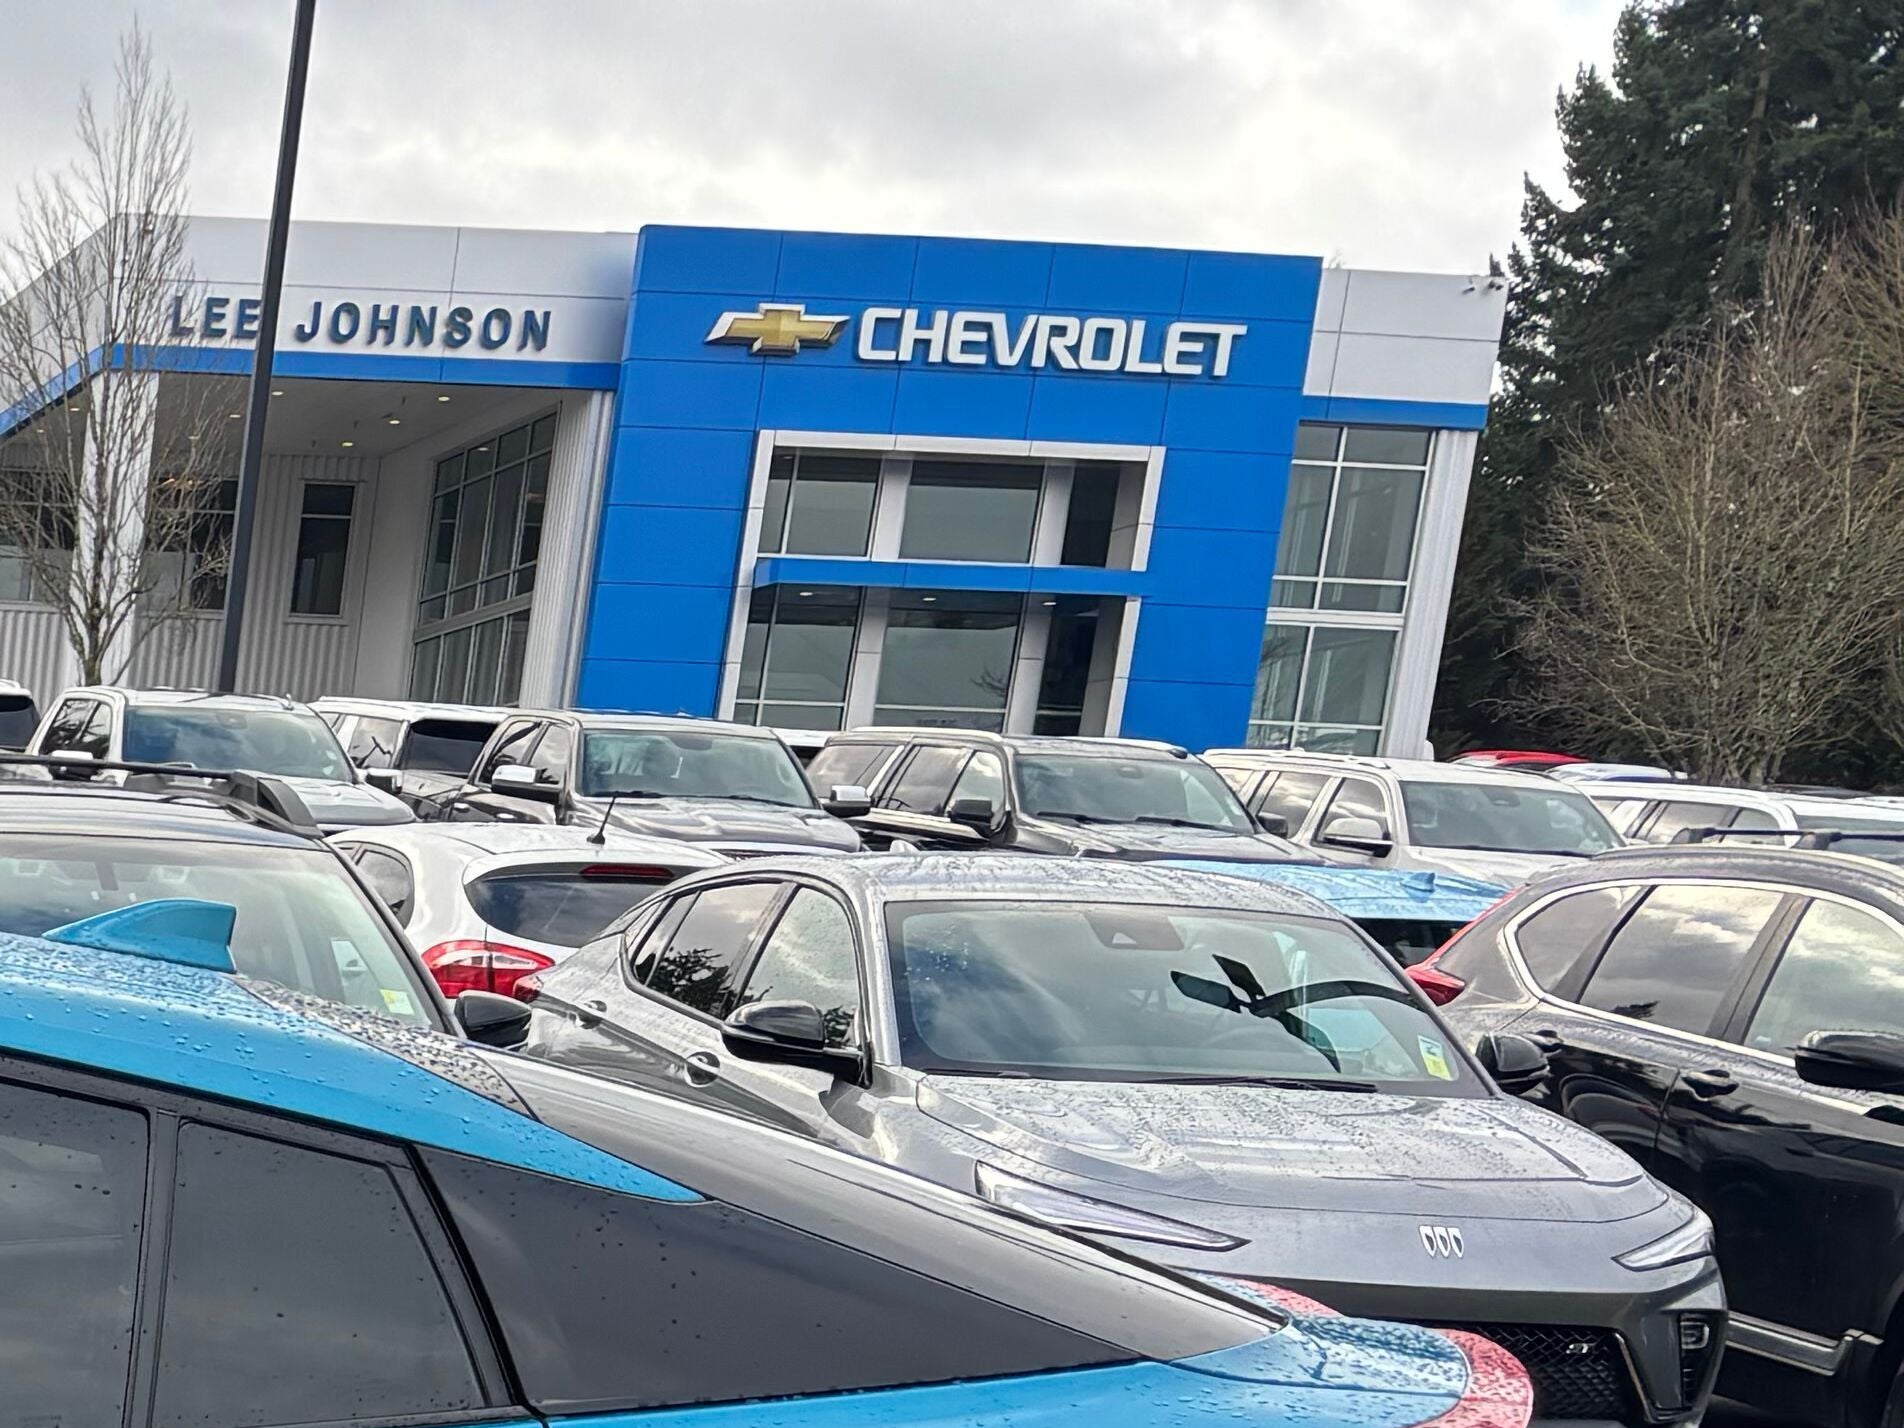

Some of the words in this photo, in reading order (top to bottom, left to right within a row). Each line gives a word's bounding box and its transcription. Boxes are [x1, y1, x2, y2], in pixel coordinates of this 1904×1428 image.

[171, 296, 262, 340] LEE
[295, 301, 552, 352] JOHNSON
[857, 307, 1249, 377] CHEVROLET
